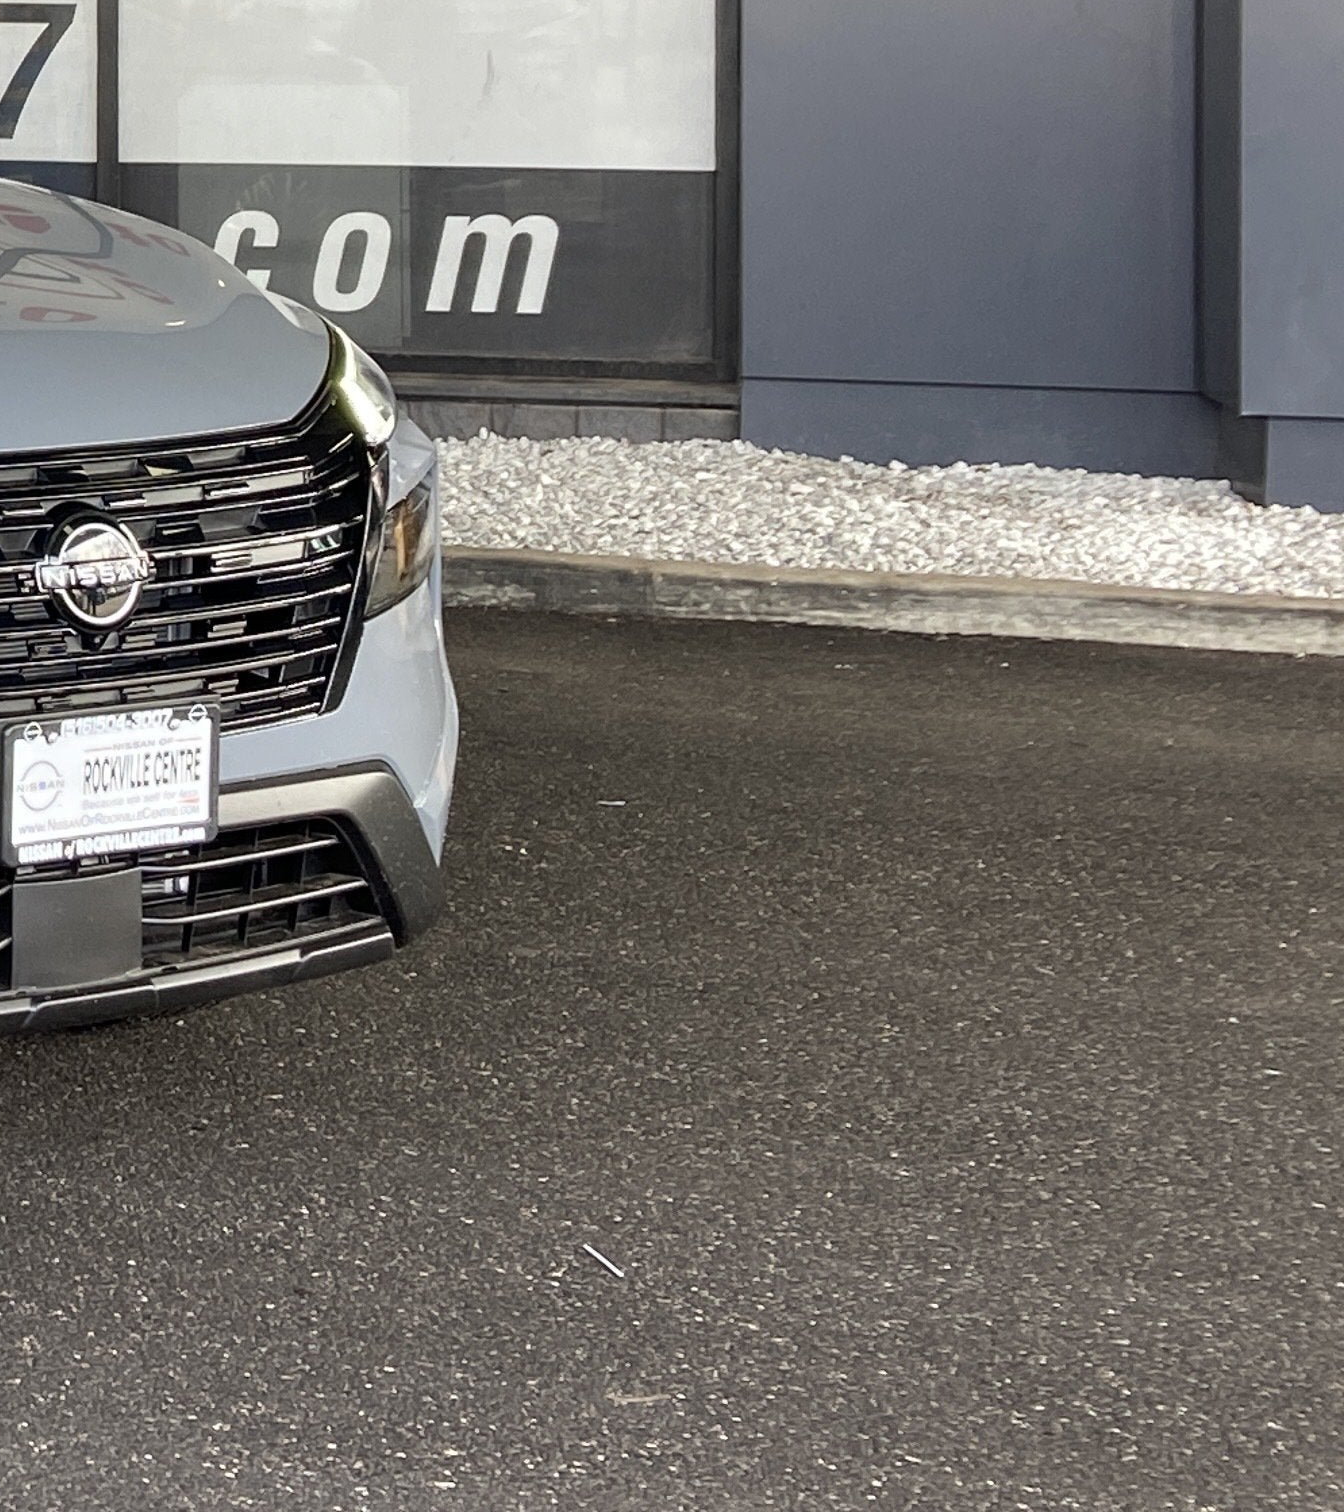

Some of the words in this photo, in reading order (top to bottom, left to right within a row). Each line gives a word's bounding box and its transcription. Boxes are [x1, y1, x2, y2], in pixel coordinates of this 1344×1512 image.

[41, 555, 150, 588] NISSAN
[112, 738, 156, 750] NISSAN
[82, 752, 150, 795] ROCKVILLE
[153, 746, 202, 787] CENTRE
[16, 780, 65, 792] NISSAN
